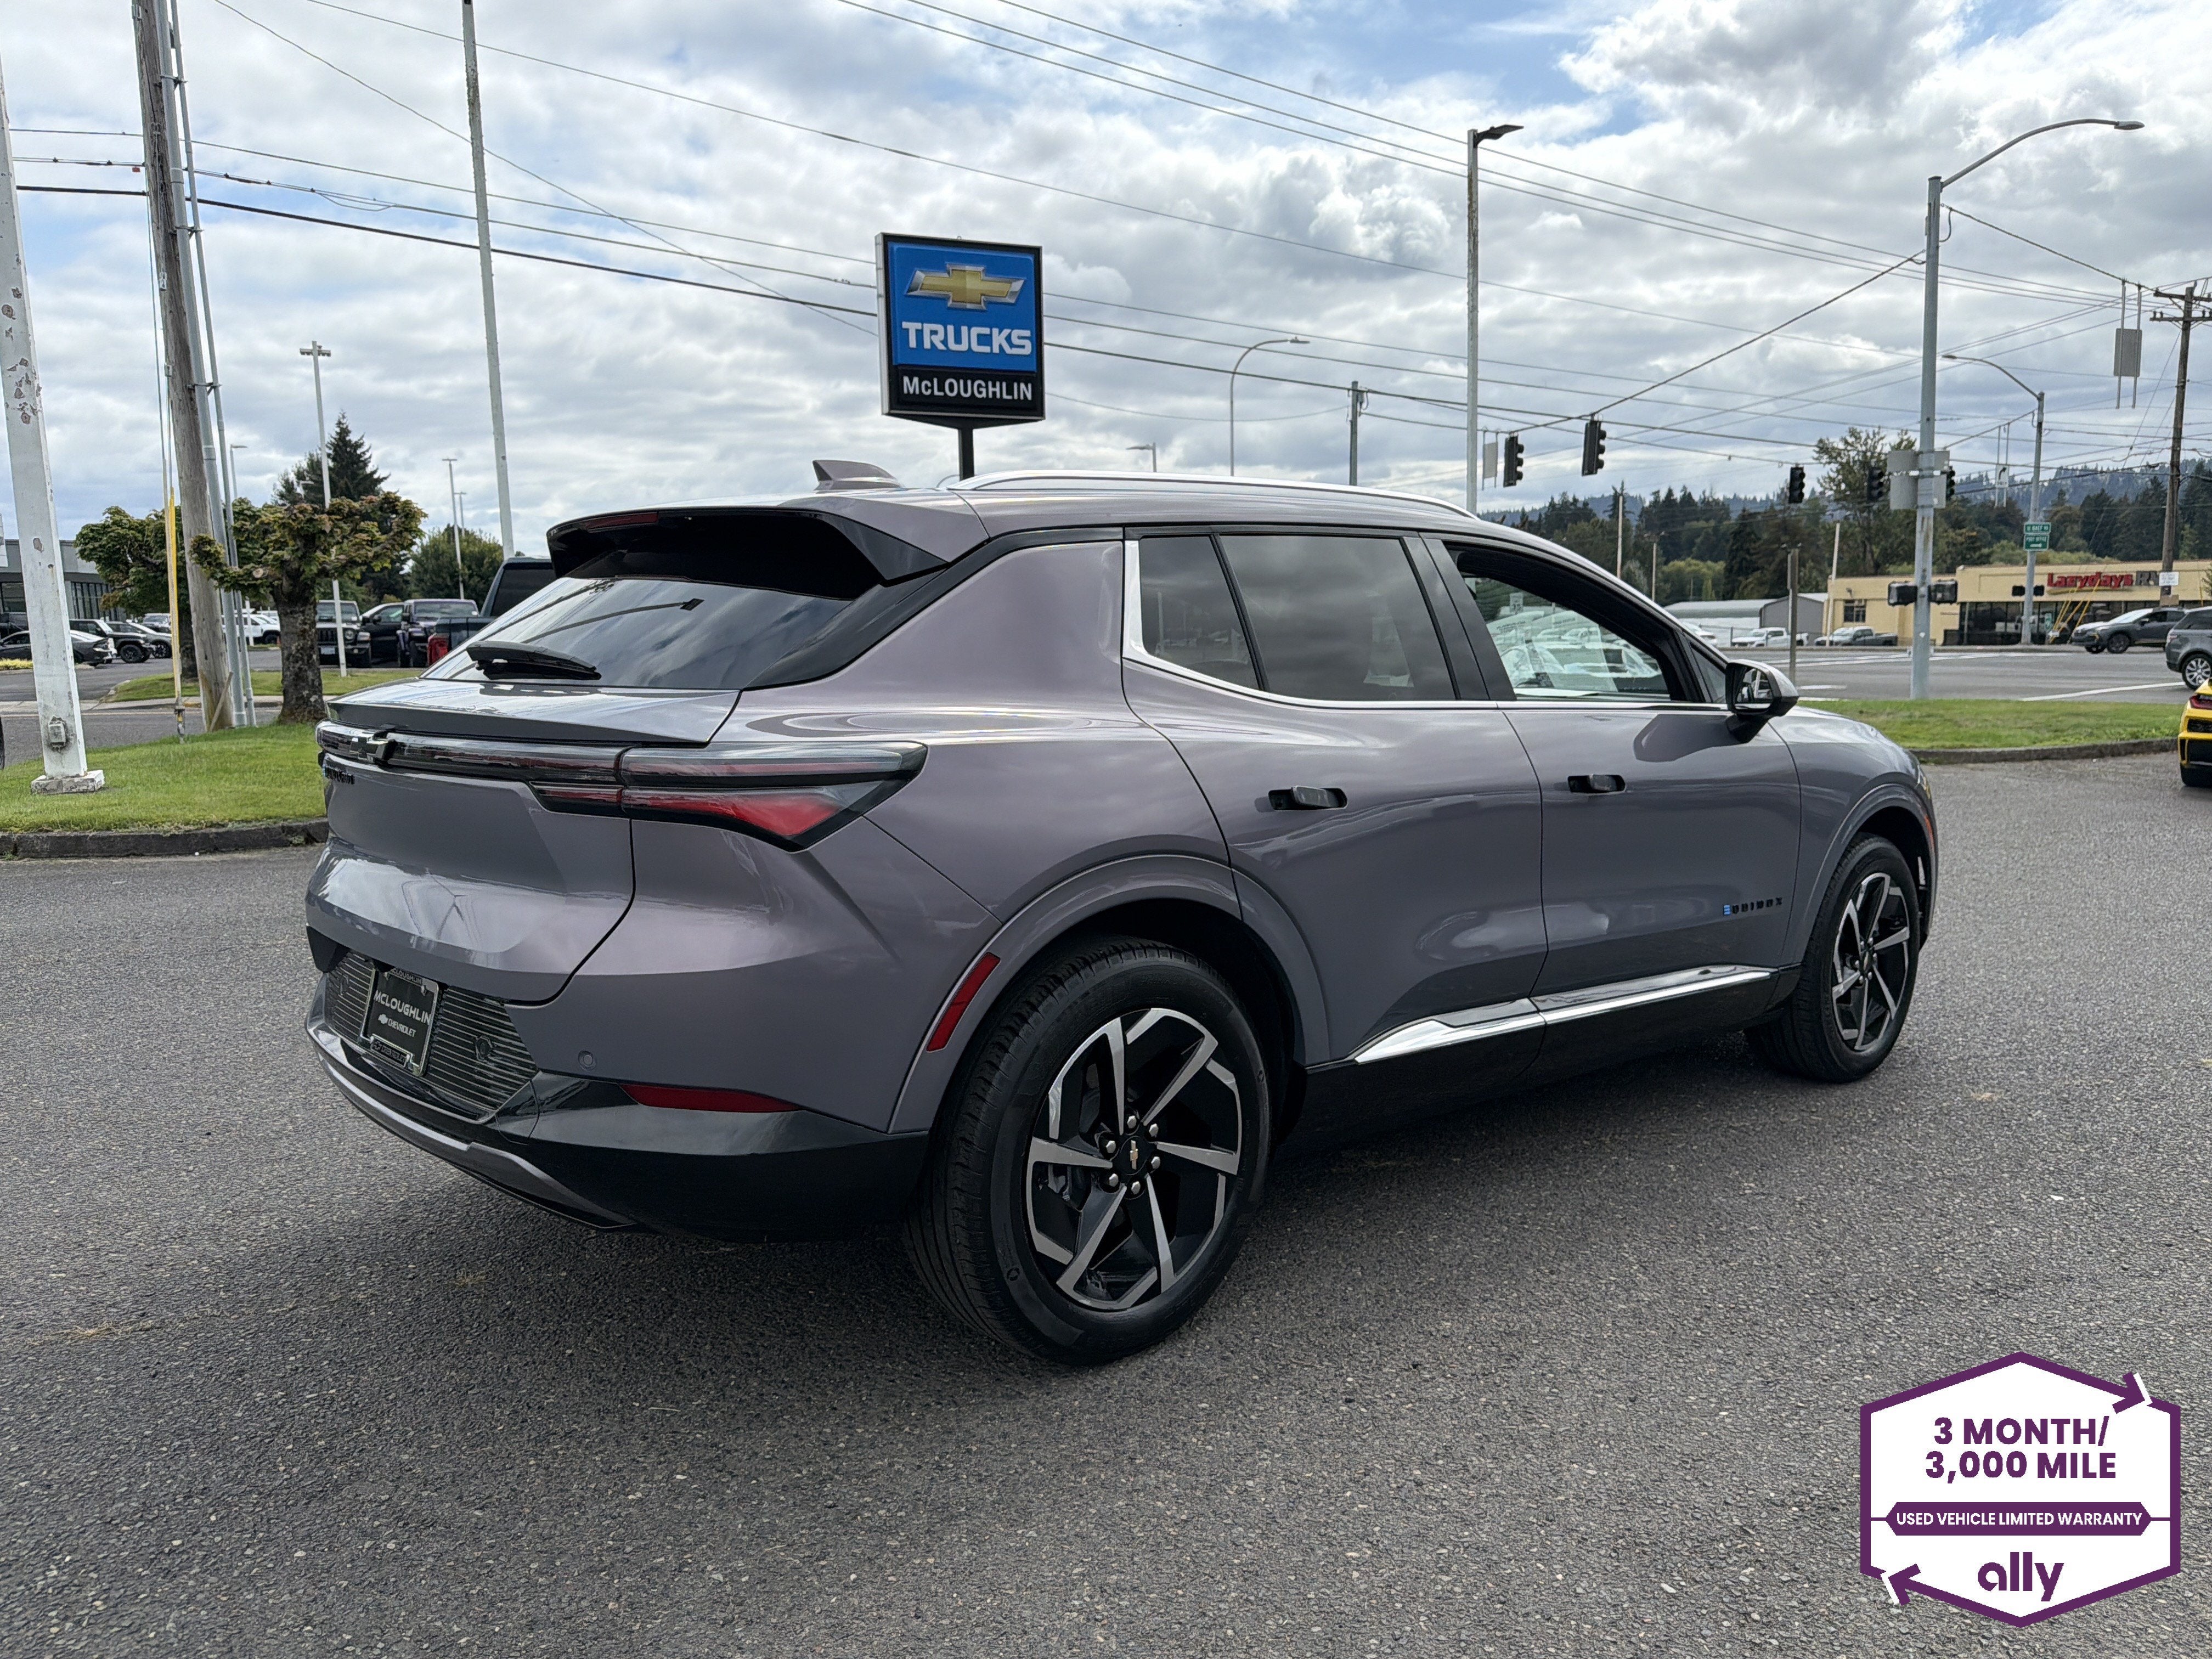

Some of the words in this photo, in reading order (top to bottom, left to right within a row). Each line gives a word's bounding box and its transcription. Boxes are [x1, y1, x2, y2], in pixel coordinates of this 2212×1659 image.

[901, 321, 1032, 355] TRUCKS
[902, 375, 1032, 400] McLOUGHLIN
[2047, 572, 2134, 589] Lazydays
[374, 989, 432, 1026] MCLOUGHLIN
[387, 1018, 416, 1037] CHEVROLET
